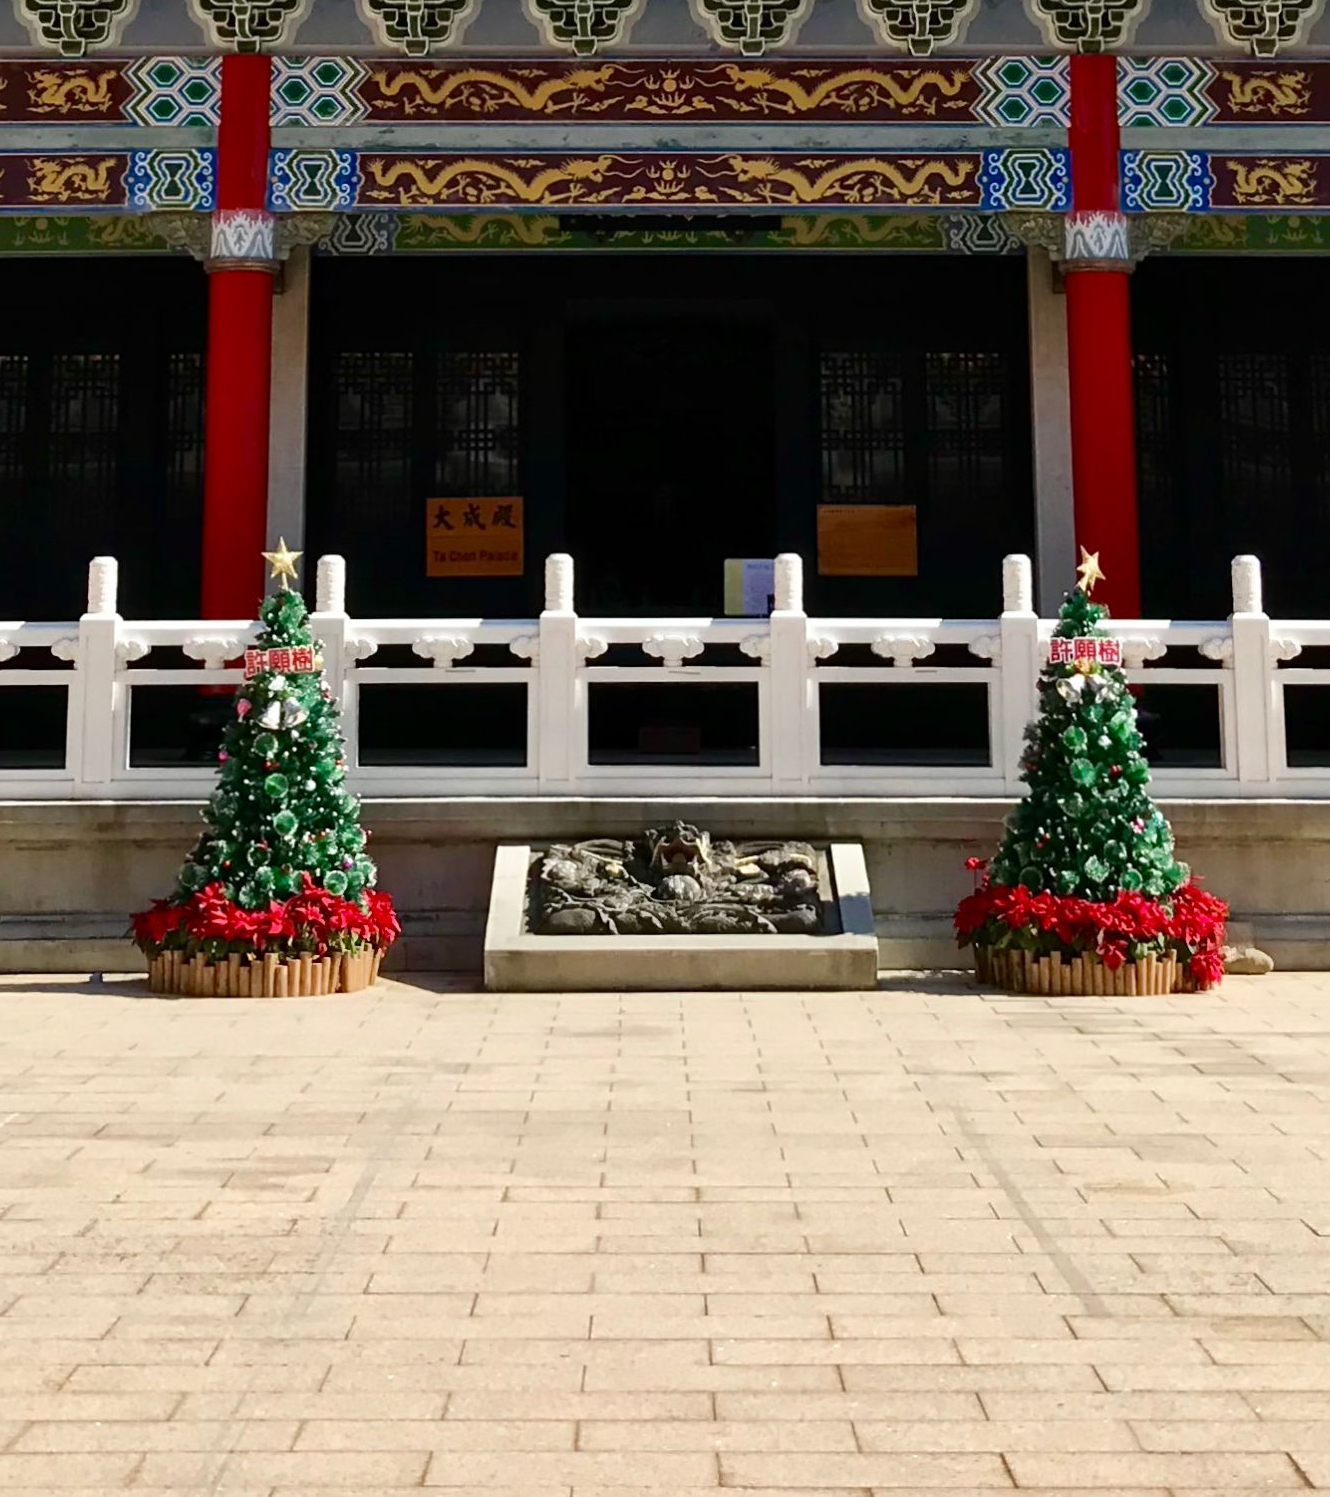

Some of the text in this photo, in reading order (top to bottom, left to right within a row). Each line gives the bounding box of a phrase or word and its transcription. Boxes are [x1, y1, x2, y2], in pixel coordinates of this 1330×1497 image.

[433, 503, 517, 530] 大成殿
[479, 549, 518, 562] Palace
[245, 645, 314, 676] 許願樹
[1050, 638, 1120, 663] 許願樹
